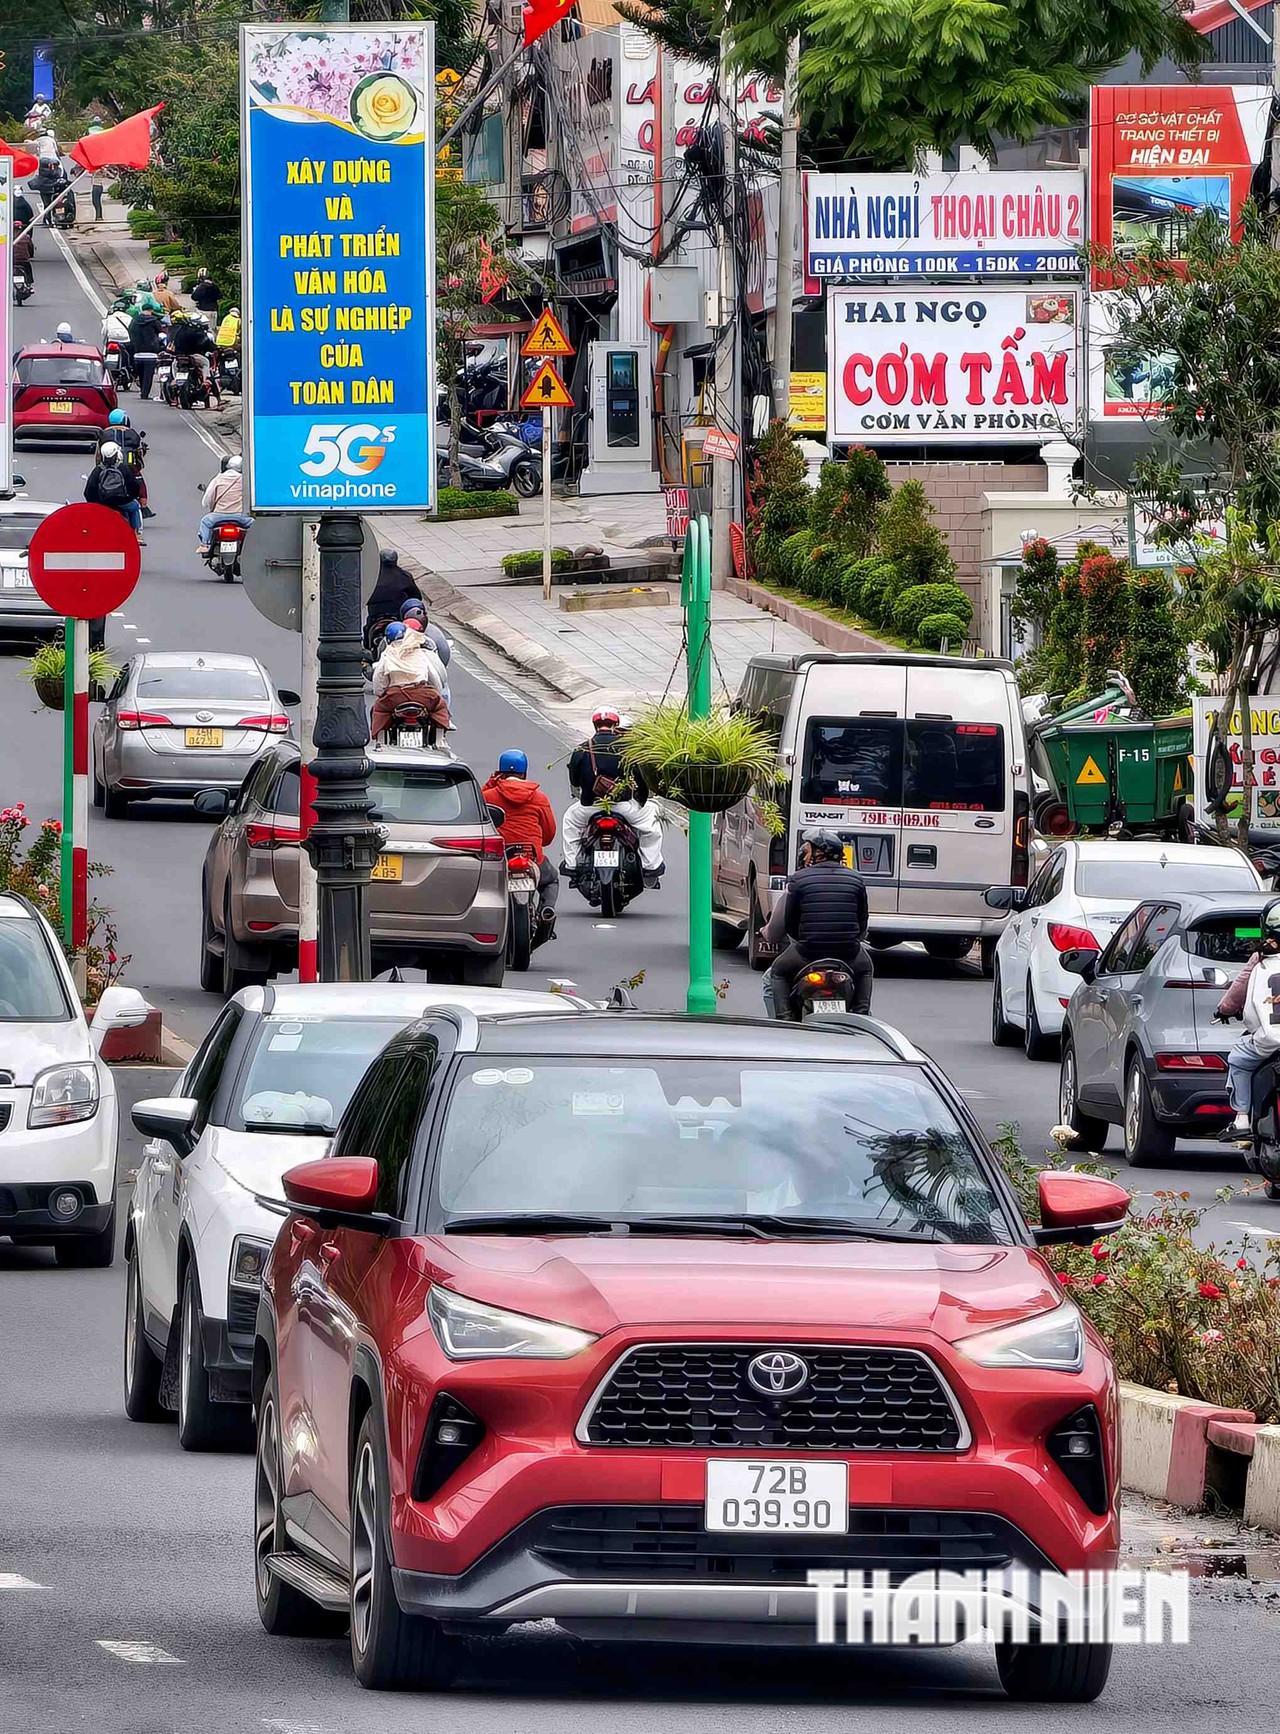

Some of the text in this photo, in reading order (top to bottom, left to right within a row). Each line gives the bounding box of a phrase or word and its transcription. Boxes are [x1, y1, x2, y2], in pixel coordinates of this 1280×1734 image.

[1187, 109, 1223, 125] CHẤT
[1120, 129, 1166, 141] TRANG
[1168, 125, 1205, 141] THIẾT
[1130, 144, 1210, 168] HIỆN ĐẠI
[287, 157, 391, 187] XÂY DỰNG
[325, 193, 354, 220] VÀ
[815, 180, 1081, 249] NHÀ NGHỈ THOẠI CHÂU 2
[280, 225, 400, 258] PHÁT TRIỂN
[814, 256, 844, 273] GIÁ
[848, 255, 910, 273] PHÒNG
[915, 257, 959, 272] 100K
[975, 257, 1020, 272] 150K
[1035, 256, 1081, 272] 200K
[294, 267, 387, 295] VĂN HÓA
[271, 303, 412, 335] LÀ SỰ NGHIỆP
[845, 300, 987, 328] HAI NGỌ
[320, 339, 364, 368] CỦA
[842, 342, 949, 406] CƠM
[960, 327, 1069, 406] TẤM
[289, 376, 394, 404] TOÀN DÂN
[860, 409, 1054, 431] CƠM VĂN PHÒNG
[290, 480, 397, 501] vinaphone
[1119, 748, 1150, 762] F-15
[804, 811, 845, 820] TRANSIT
[748, 1465, 807, 1494] 72B
[722, 1499, 831, 1528] 039.90
